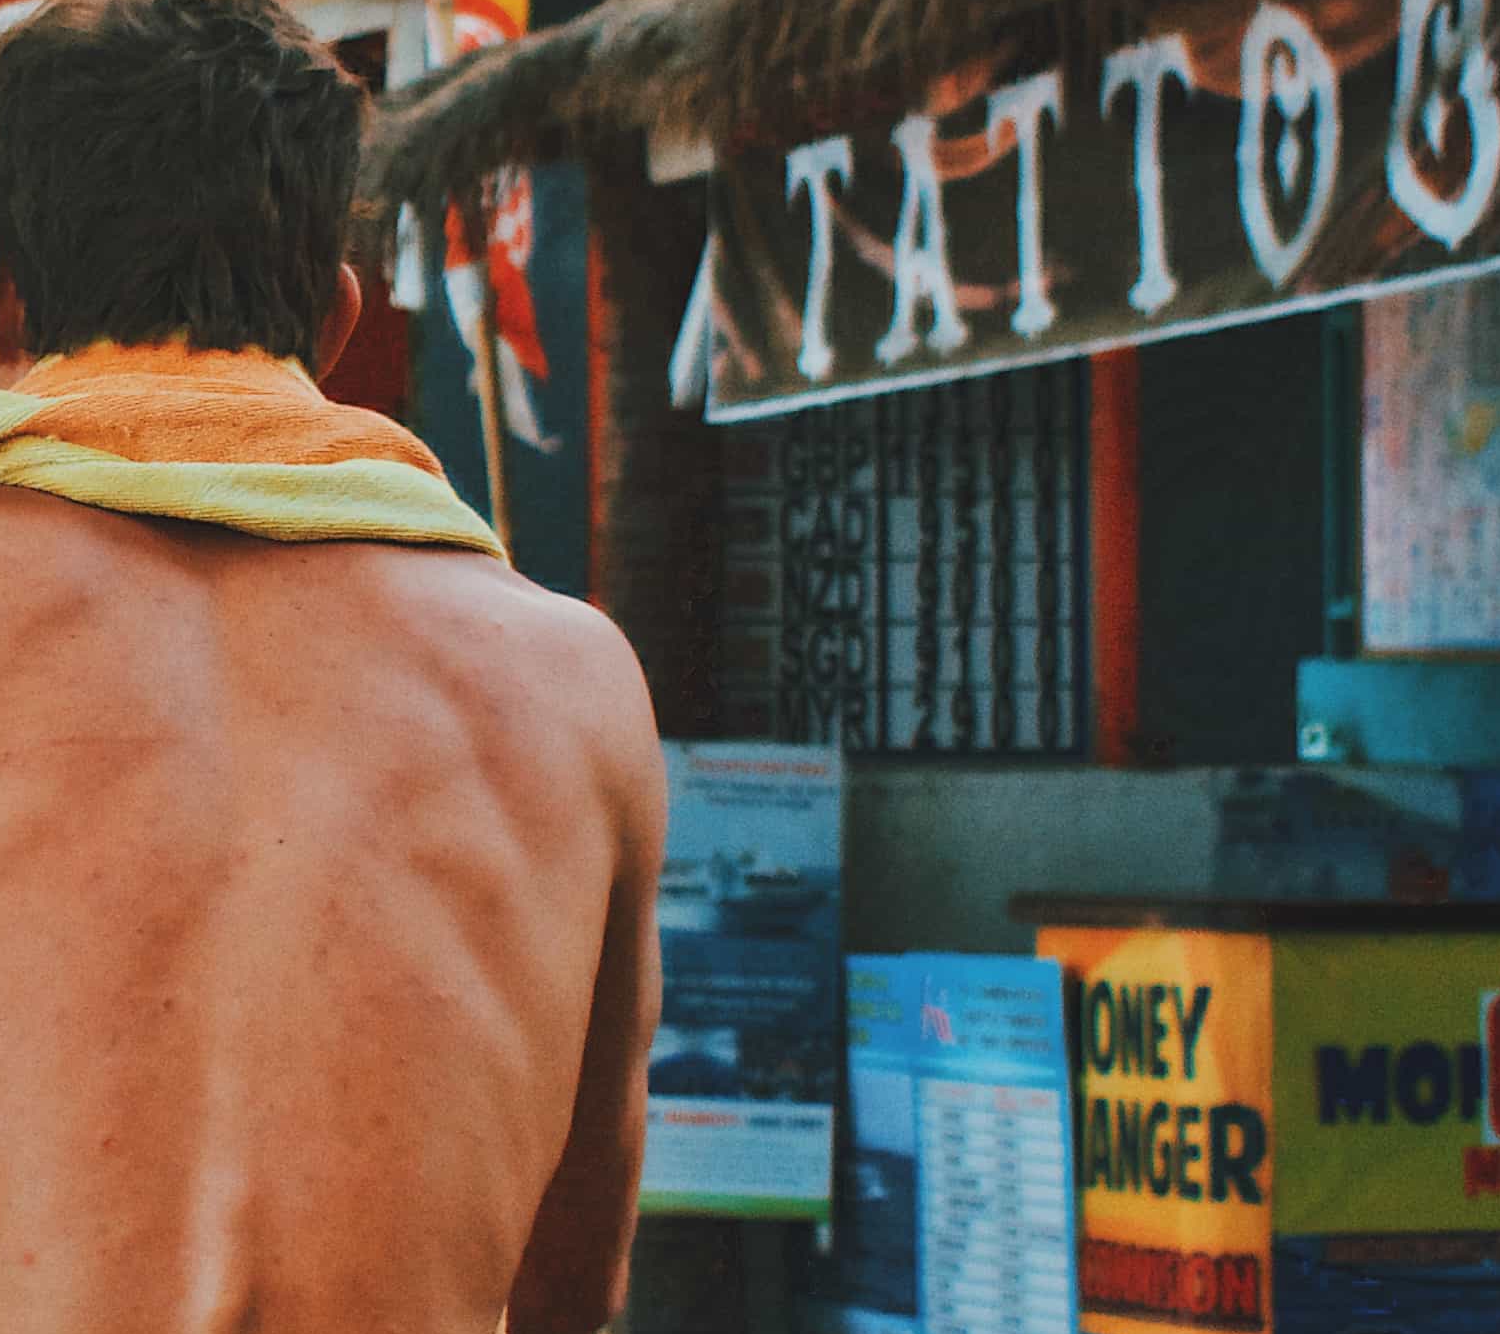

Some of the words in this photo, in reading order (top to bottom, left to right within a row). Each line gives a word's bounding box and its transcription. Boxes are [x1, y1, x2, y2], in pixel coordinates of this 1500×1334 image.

[781, 494, 868, 555] CAD
[781, 624, 868, 685] SGD
[778, 688, 869, 748] MYR
[1082, 980, 1212, 1081] ONEY
[1082, 1098, 1266, 1204] ANGER
